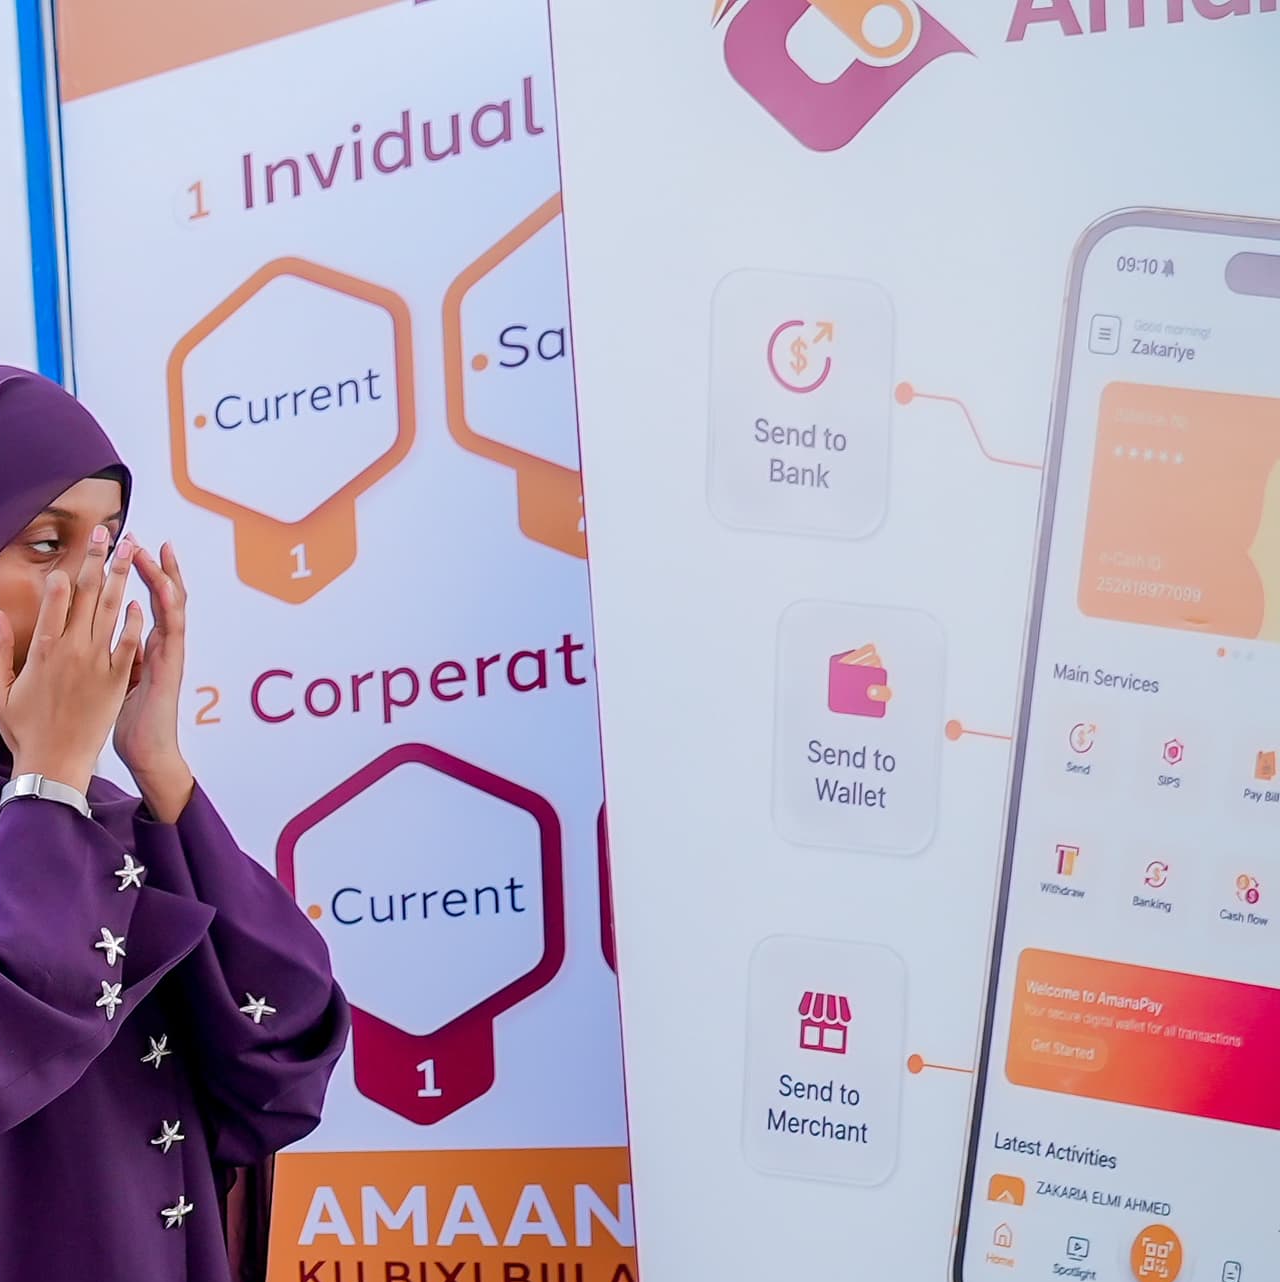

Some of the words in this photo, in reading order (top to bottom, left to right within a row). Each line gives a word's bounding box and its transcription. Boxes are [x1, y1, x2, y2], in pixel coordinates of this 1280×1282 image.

[243, 76, 544, 209] Invidual
[1117, 256, 1158, 274] 09:10
[1131, 339, 1195, 362] Zakariye
[215, 369, 381, 429] Current
[755, 418, 816, 448] Send
[824, 428, 846, 451] to
[770, 458, 830, 488] Bank
[291, 544, 312, 578] 1
[196, 686, 221, 725] 2
[251, 634, 587, 723] Corperat
[1054, 664, 1089, 683] Main
[1094, 669, 1159, 693] Services
[808, 740, 866, 769] Send
[873, 750, 895, 772] to
[816, 778, 886, 808] Wallet
[332, 877, 525, 925] Current
[1041, 883, 1085, 898] Withdraw
[1133, 896, 1172, 913] Banking
[1220, 909, 1244, 923] Cash
[1247, 914, 1268, 925] flow
[1027, 981, 1080, 1001] Welcome
[1083, 990, 1094, 1002] to
[1096, 992, 1163, 1020] AmanaPay
[417, 1060, 441, 1097] 1
[779, 1075, 833, 1102] Send
[840, 1085, 859, 1106] to
[768, 1108, 867, 1143] Merchant
[995, 1132, 1041, 1156] Latest
[1045, 1142, 1116, 1169] Activities
[1036, 1181, 1088, 1202] ZAKARIA
[1092, 1192, 1121, 1207] ELMI
[1124, 1198, 1171, 1216] AHMED
